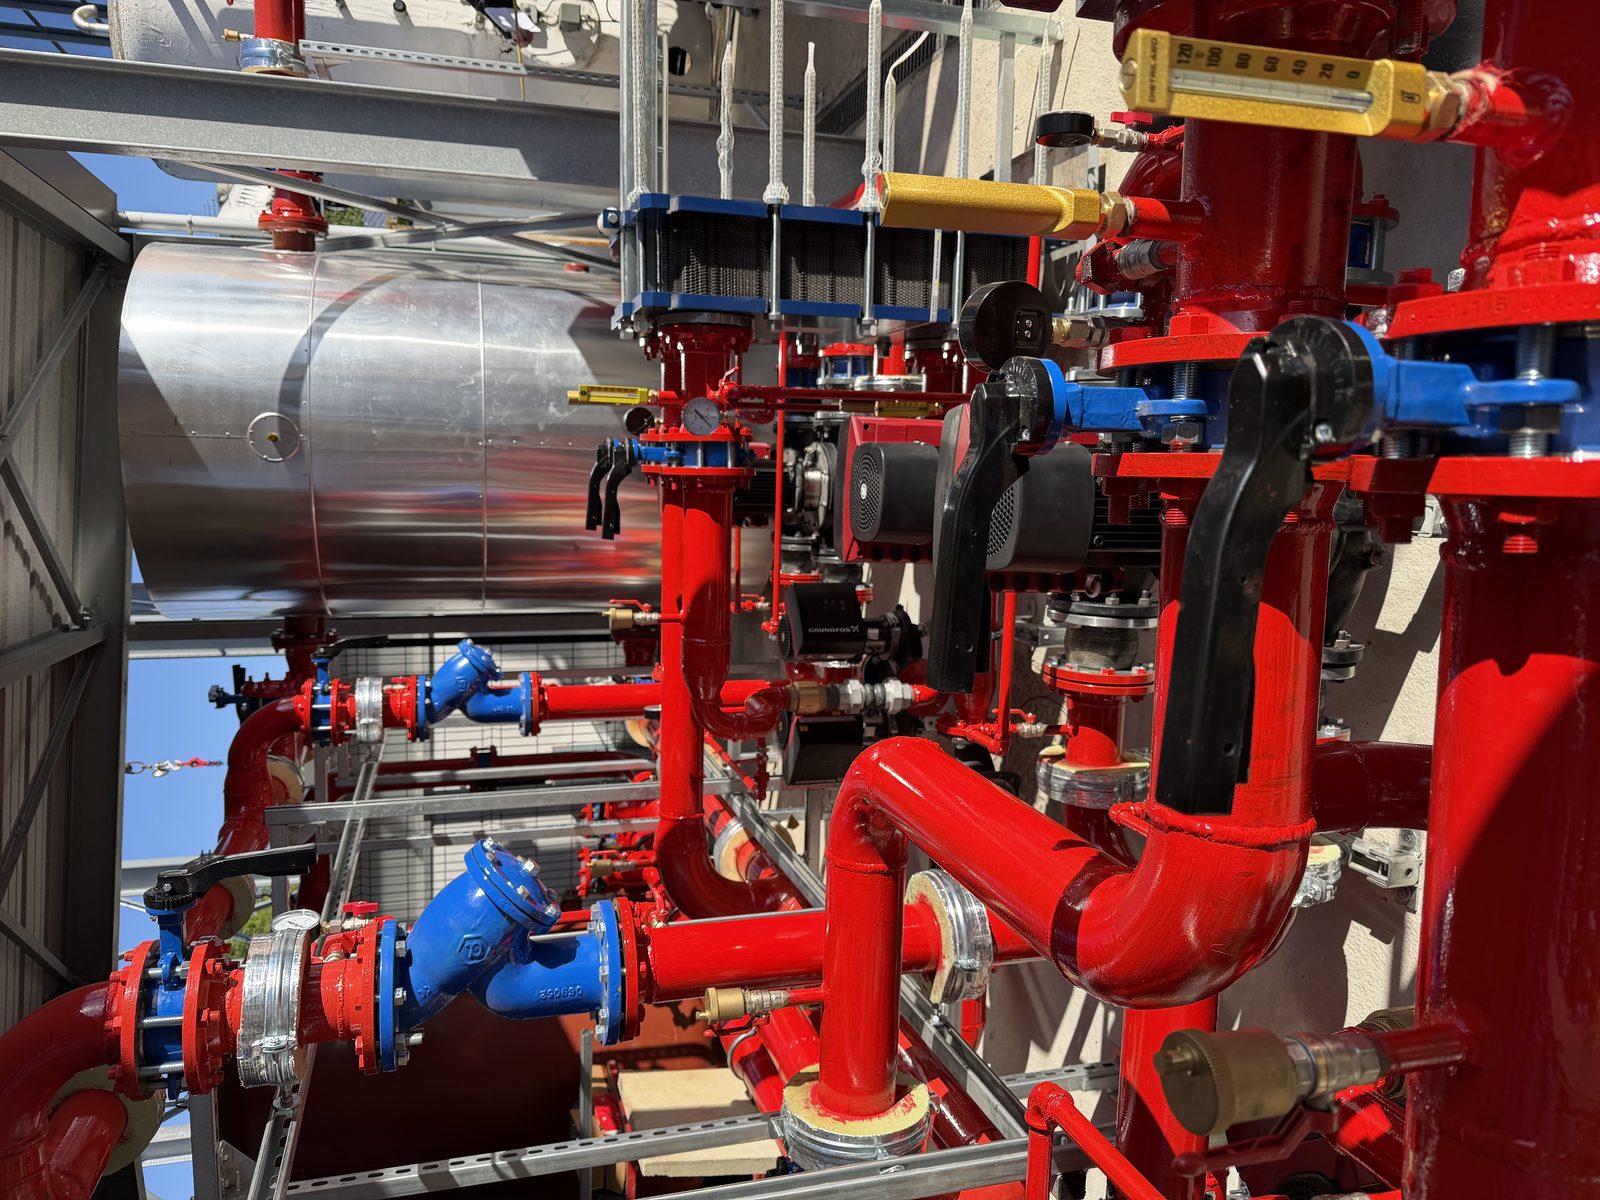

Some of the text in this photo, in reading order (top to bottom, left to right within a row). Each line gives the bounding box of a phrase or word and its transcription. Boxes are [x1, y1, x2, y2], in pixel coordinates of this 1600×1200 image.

[1177, 43, 1194, 64] 120
[1206, 46, 1223, 68] 100
[1235, 53, 1252, 70] 80
[1263, 56, 1280, 72] 60
[1292, 59, 1308, 76] 40
[1318, 63, 1335, 79] 20
[1346, 70, 1361, 79] 0
